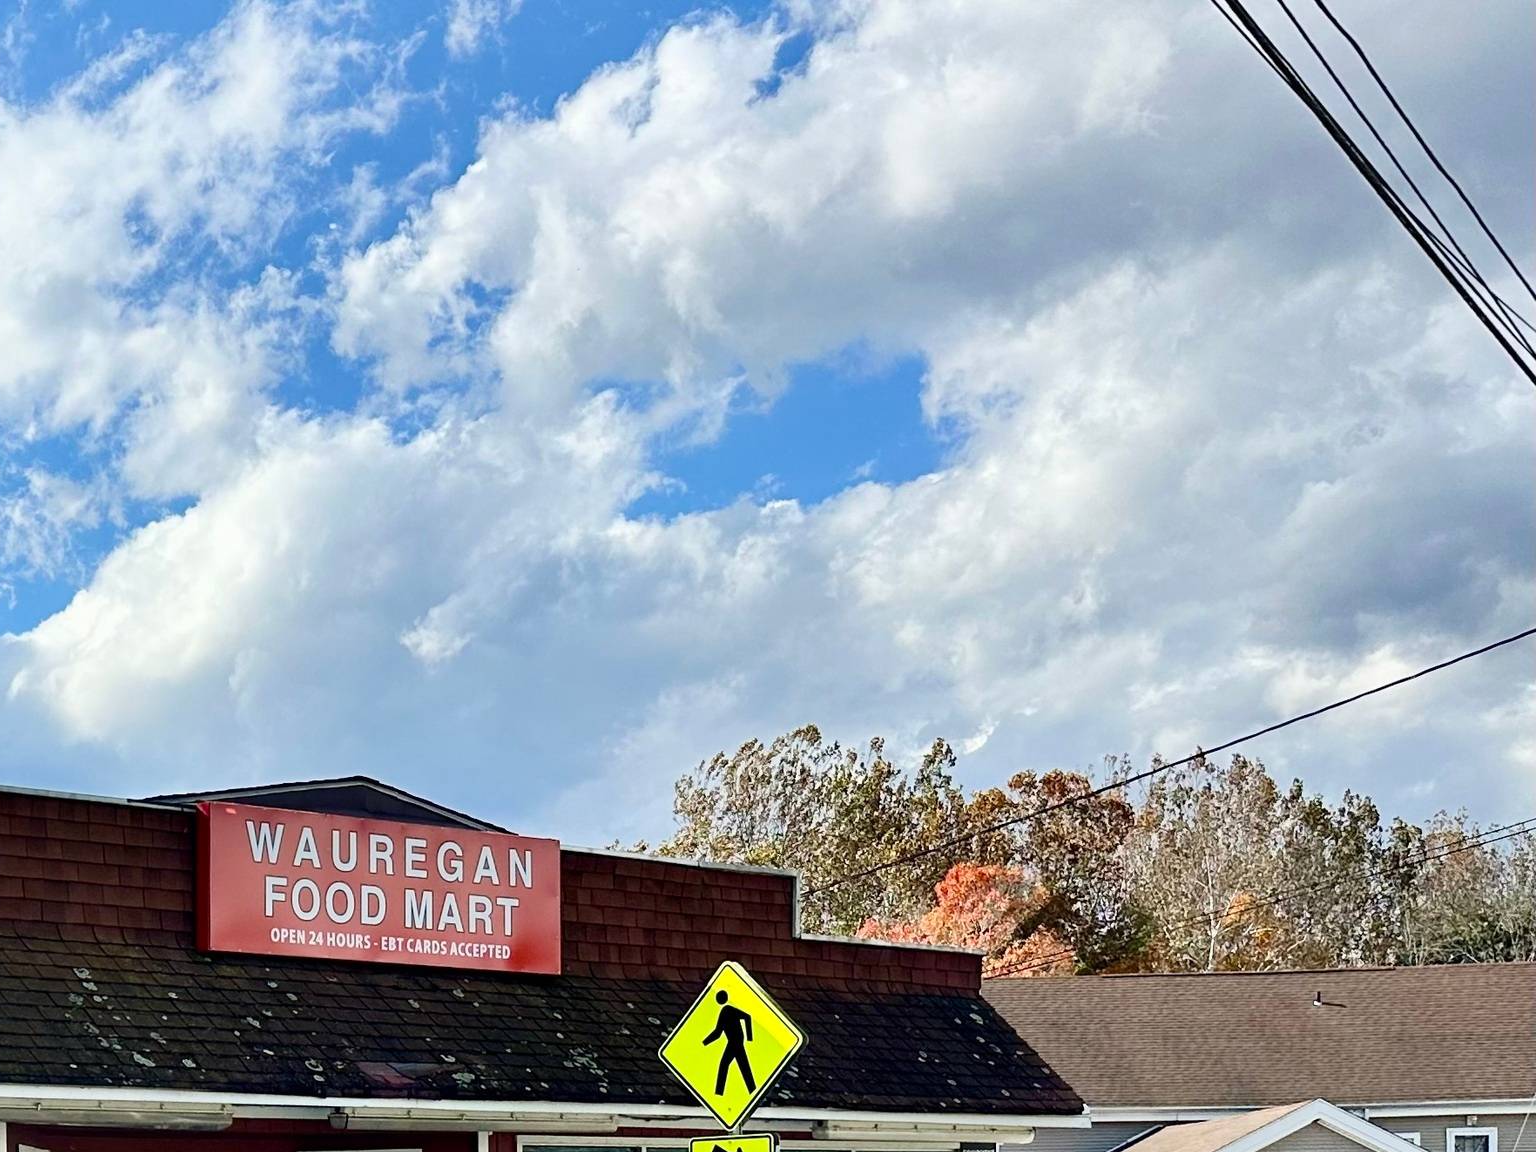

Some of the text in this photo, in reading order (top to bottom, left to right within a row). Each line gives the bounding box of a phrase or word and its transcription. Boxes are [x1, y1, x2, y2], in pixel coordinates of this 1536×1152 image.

[246, 820, 533, 889] WAUREGAN
[264, 875, 520, 936] FOOD MART
[270, 927, 306, 945] OPEN
[309, 931, 324, 946] 24
[326, 933, 371, 949] HOURS
[381, 936, 404, 951] EBT
[406, 939, 448, 955] CARDS
[449, 942, 511, 960] ACCEPTED
